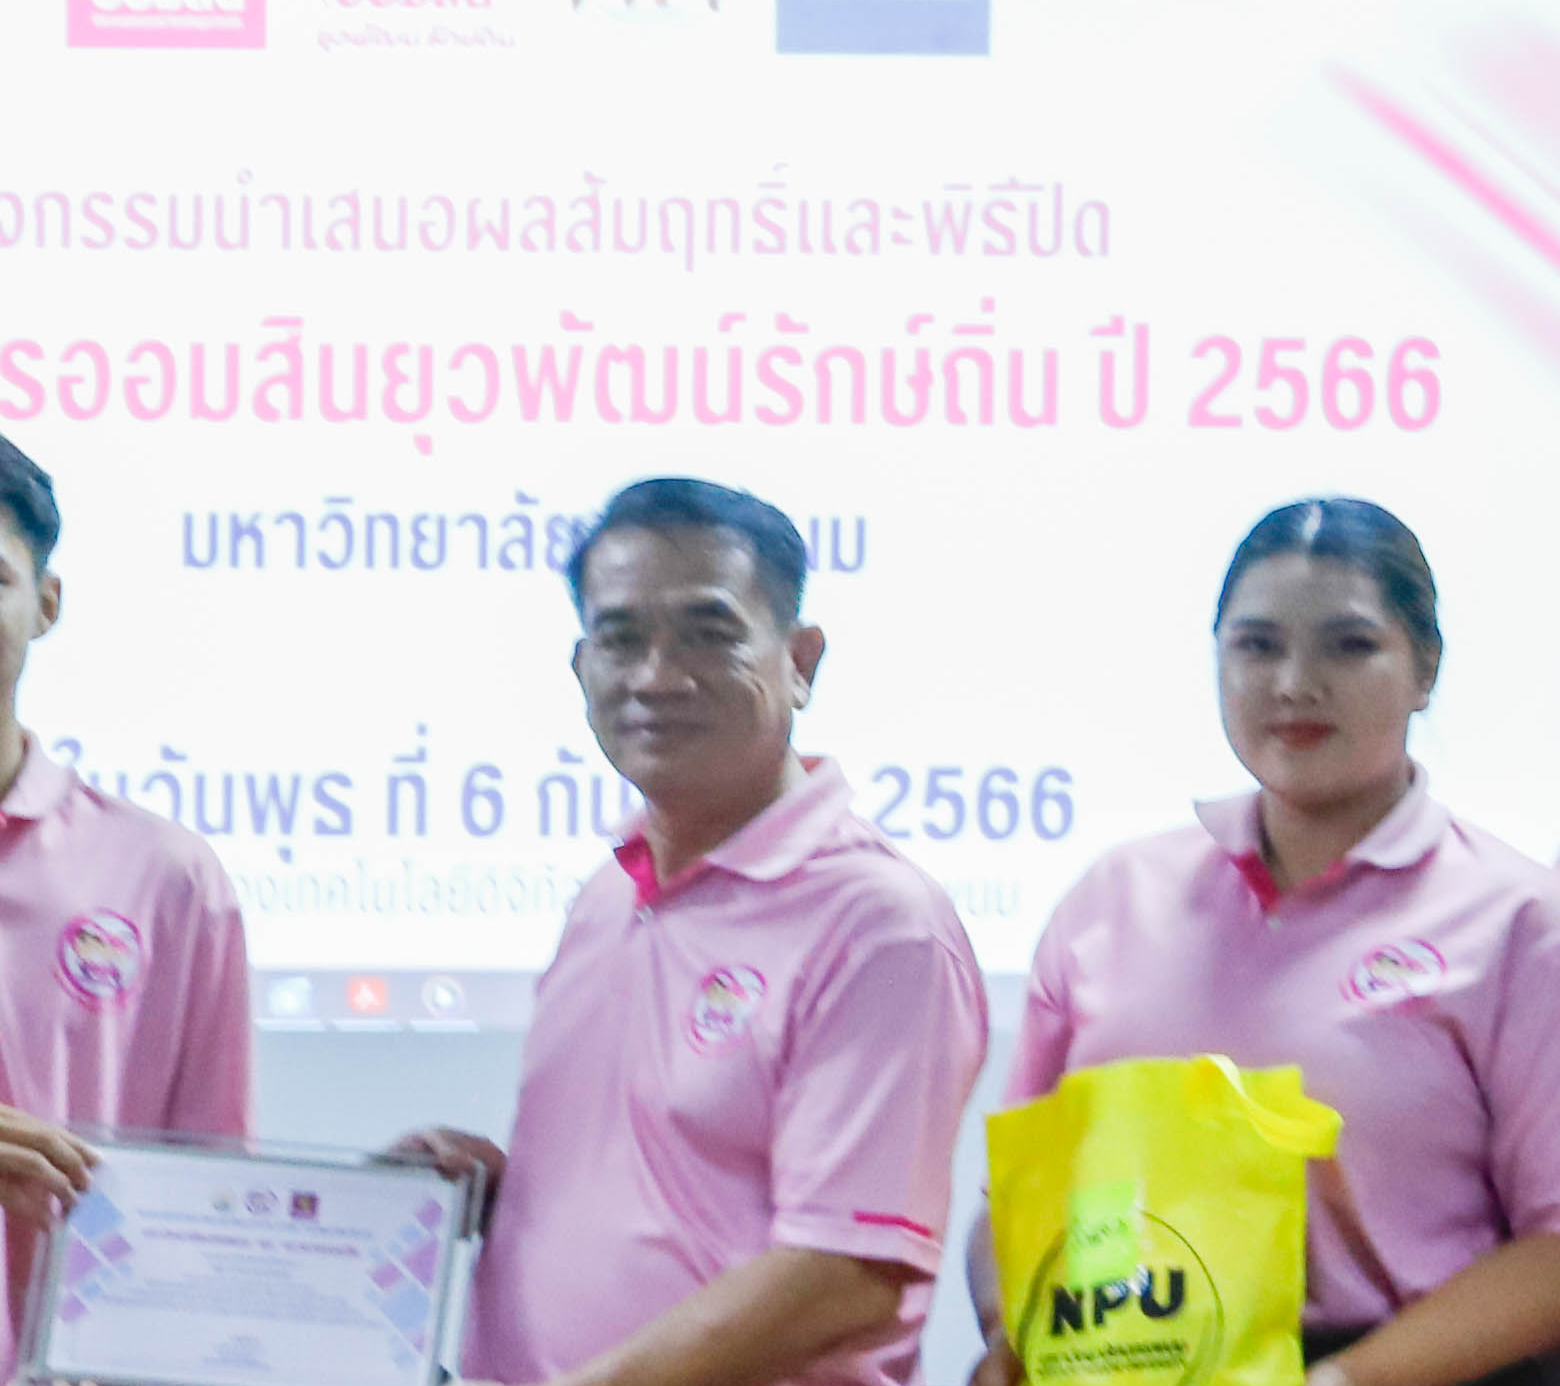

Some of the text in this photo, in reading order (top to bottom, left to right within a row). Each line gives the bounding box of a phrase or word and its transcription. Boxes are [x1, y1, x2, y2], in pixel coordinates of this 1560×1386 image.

[1090, 316, 1152, 431] ปี
[1187, 335, 1443, 433] 2566
[182, 489, 869, 576] มหาวิทยาลัยม
[385, 723, 431, 839] ที่
[460, 760, 509, 841] 6
[870, 763, 1078, 842] 2566
[1050, 1268, 1187, 1337] NPU
